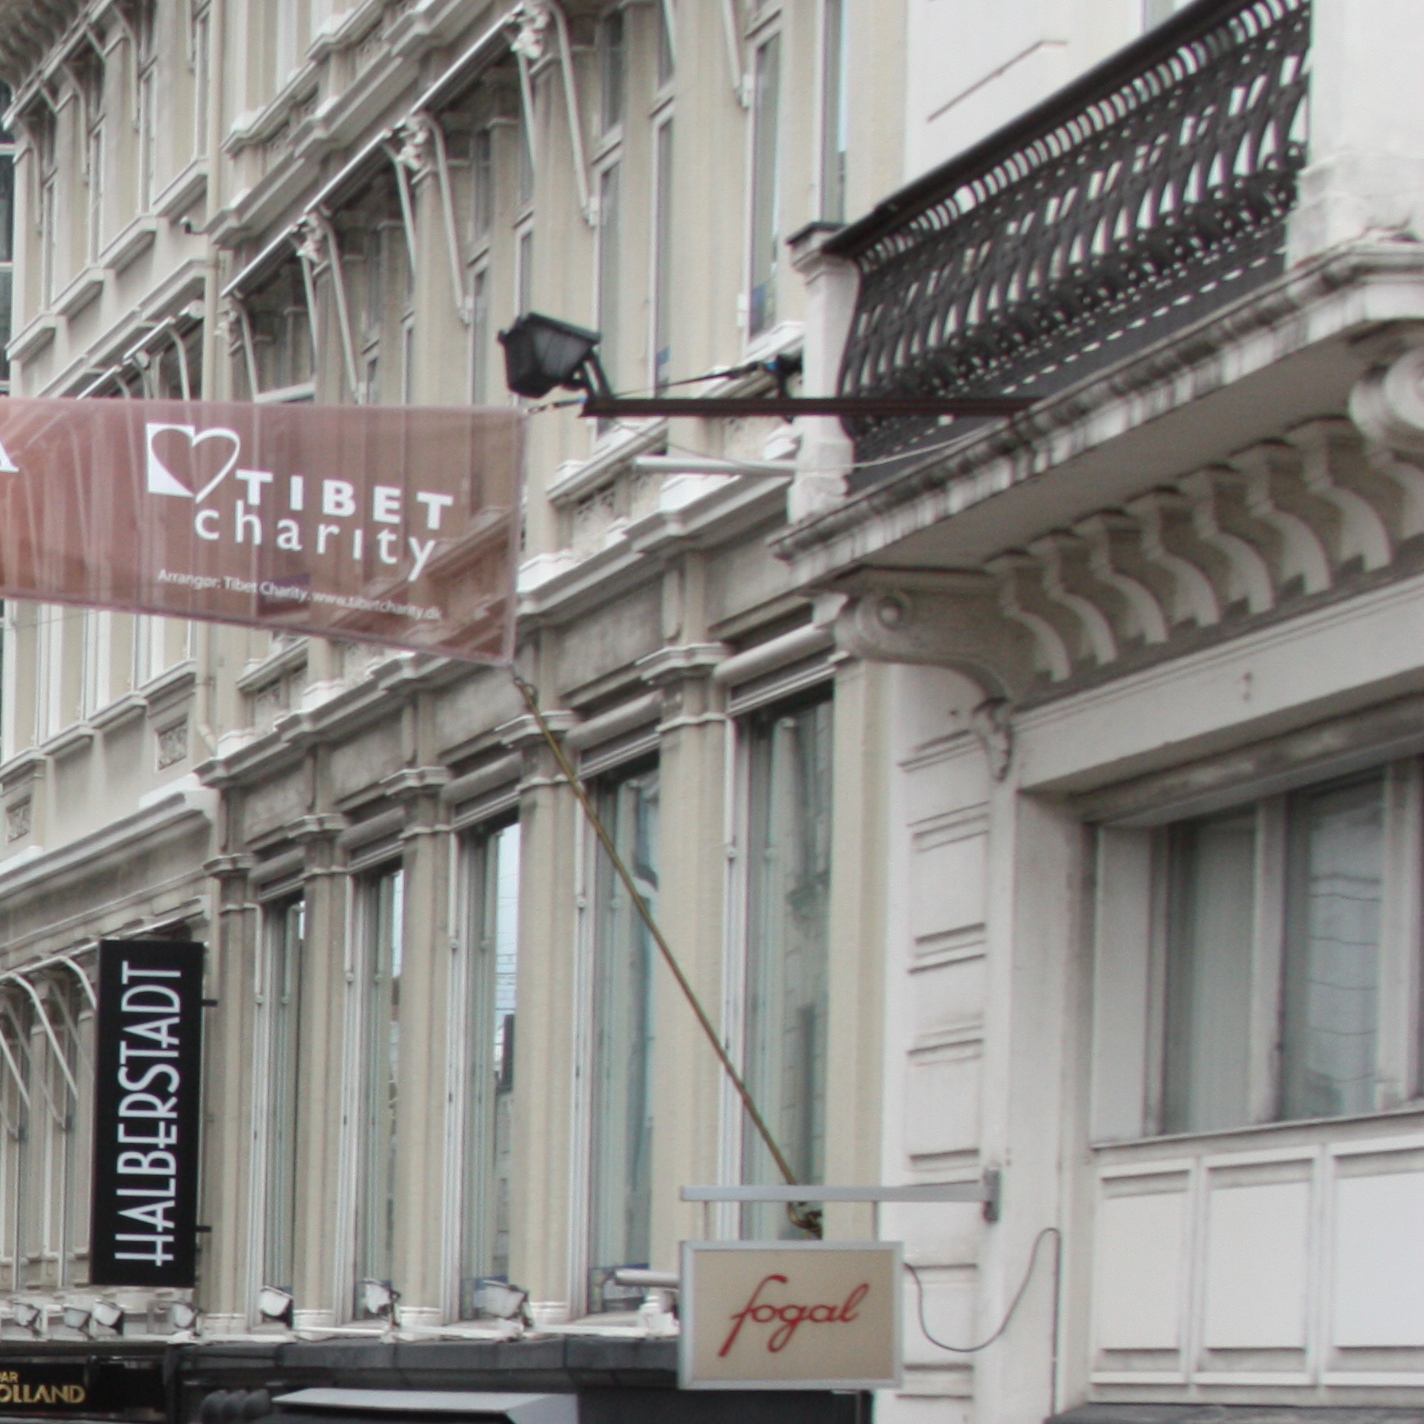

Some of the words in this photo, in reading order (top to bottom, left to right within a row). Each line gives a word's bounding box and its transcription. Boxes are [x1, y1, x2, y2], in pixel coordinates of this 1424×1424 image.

[236, 469, 453, 530] TIBET
[195, 500, 436, 582] charity
[224, 575, 257, 594] Tibet
[114, 961, 182, 1267] HALBERSTADT
[718, 1273, 870, 1358] fogal
